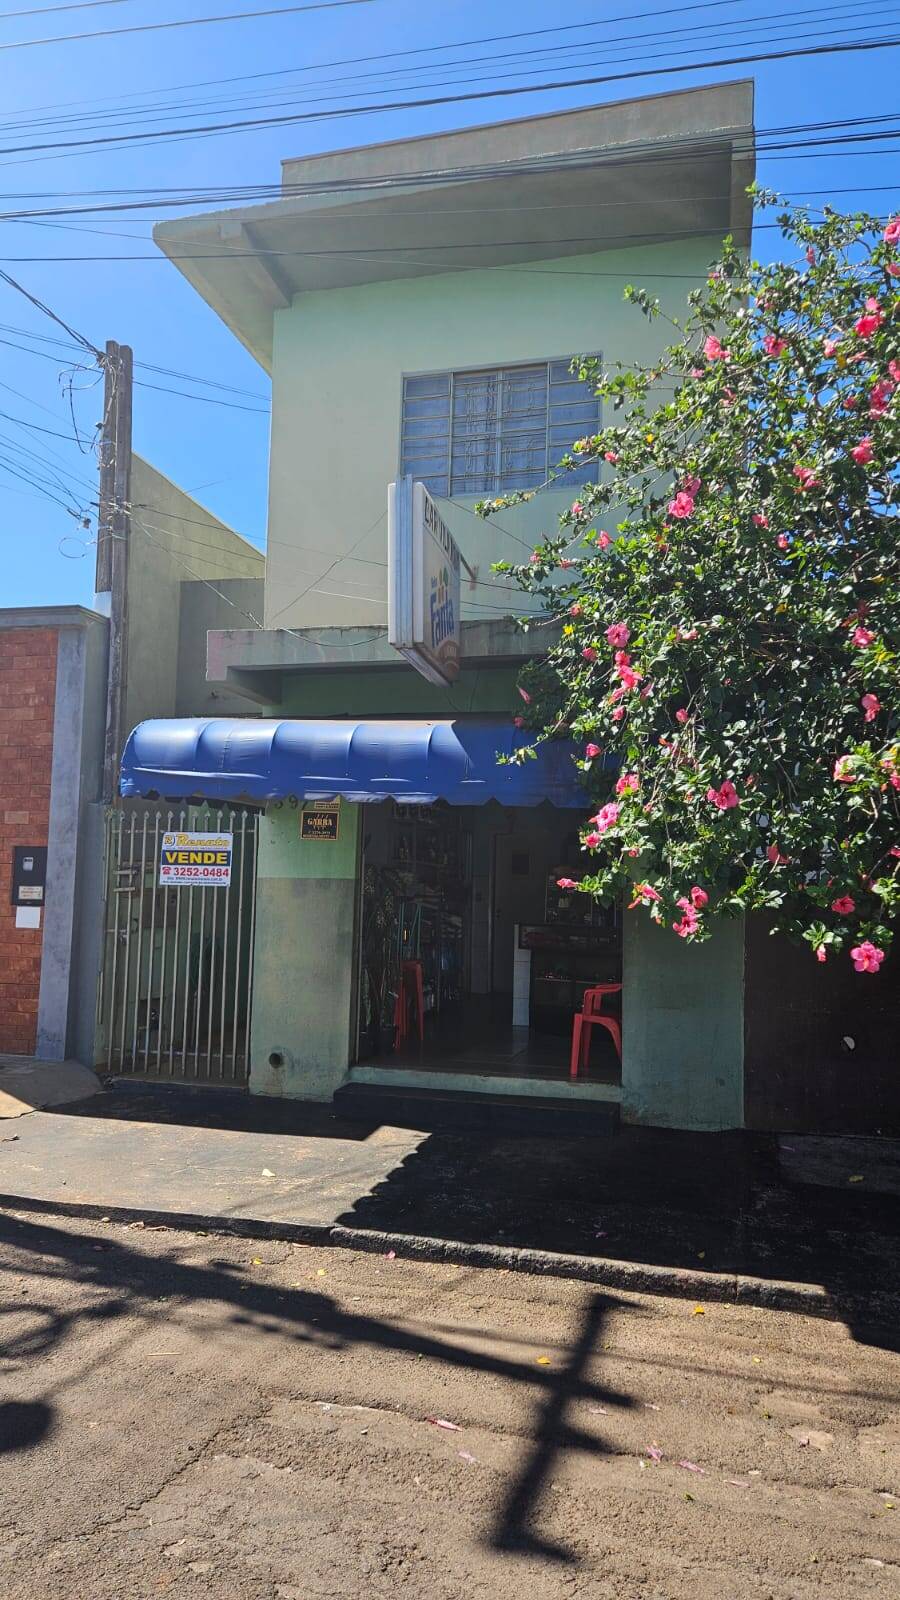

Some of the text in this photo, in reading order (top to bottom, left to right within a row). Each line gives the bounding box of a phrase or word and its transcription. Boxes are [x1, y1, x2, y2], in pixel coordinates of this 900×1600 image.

[307, 818, 333, 826] GARRA
[175, 834, 230, 847] Renato
[165, 852, 228, 865] VENDE
[174, 867, 229, 877] 3252-0484
